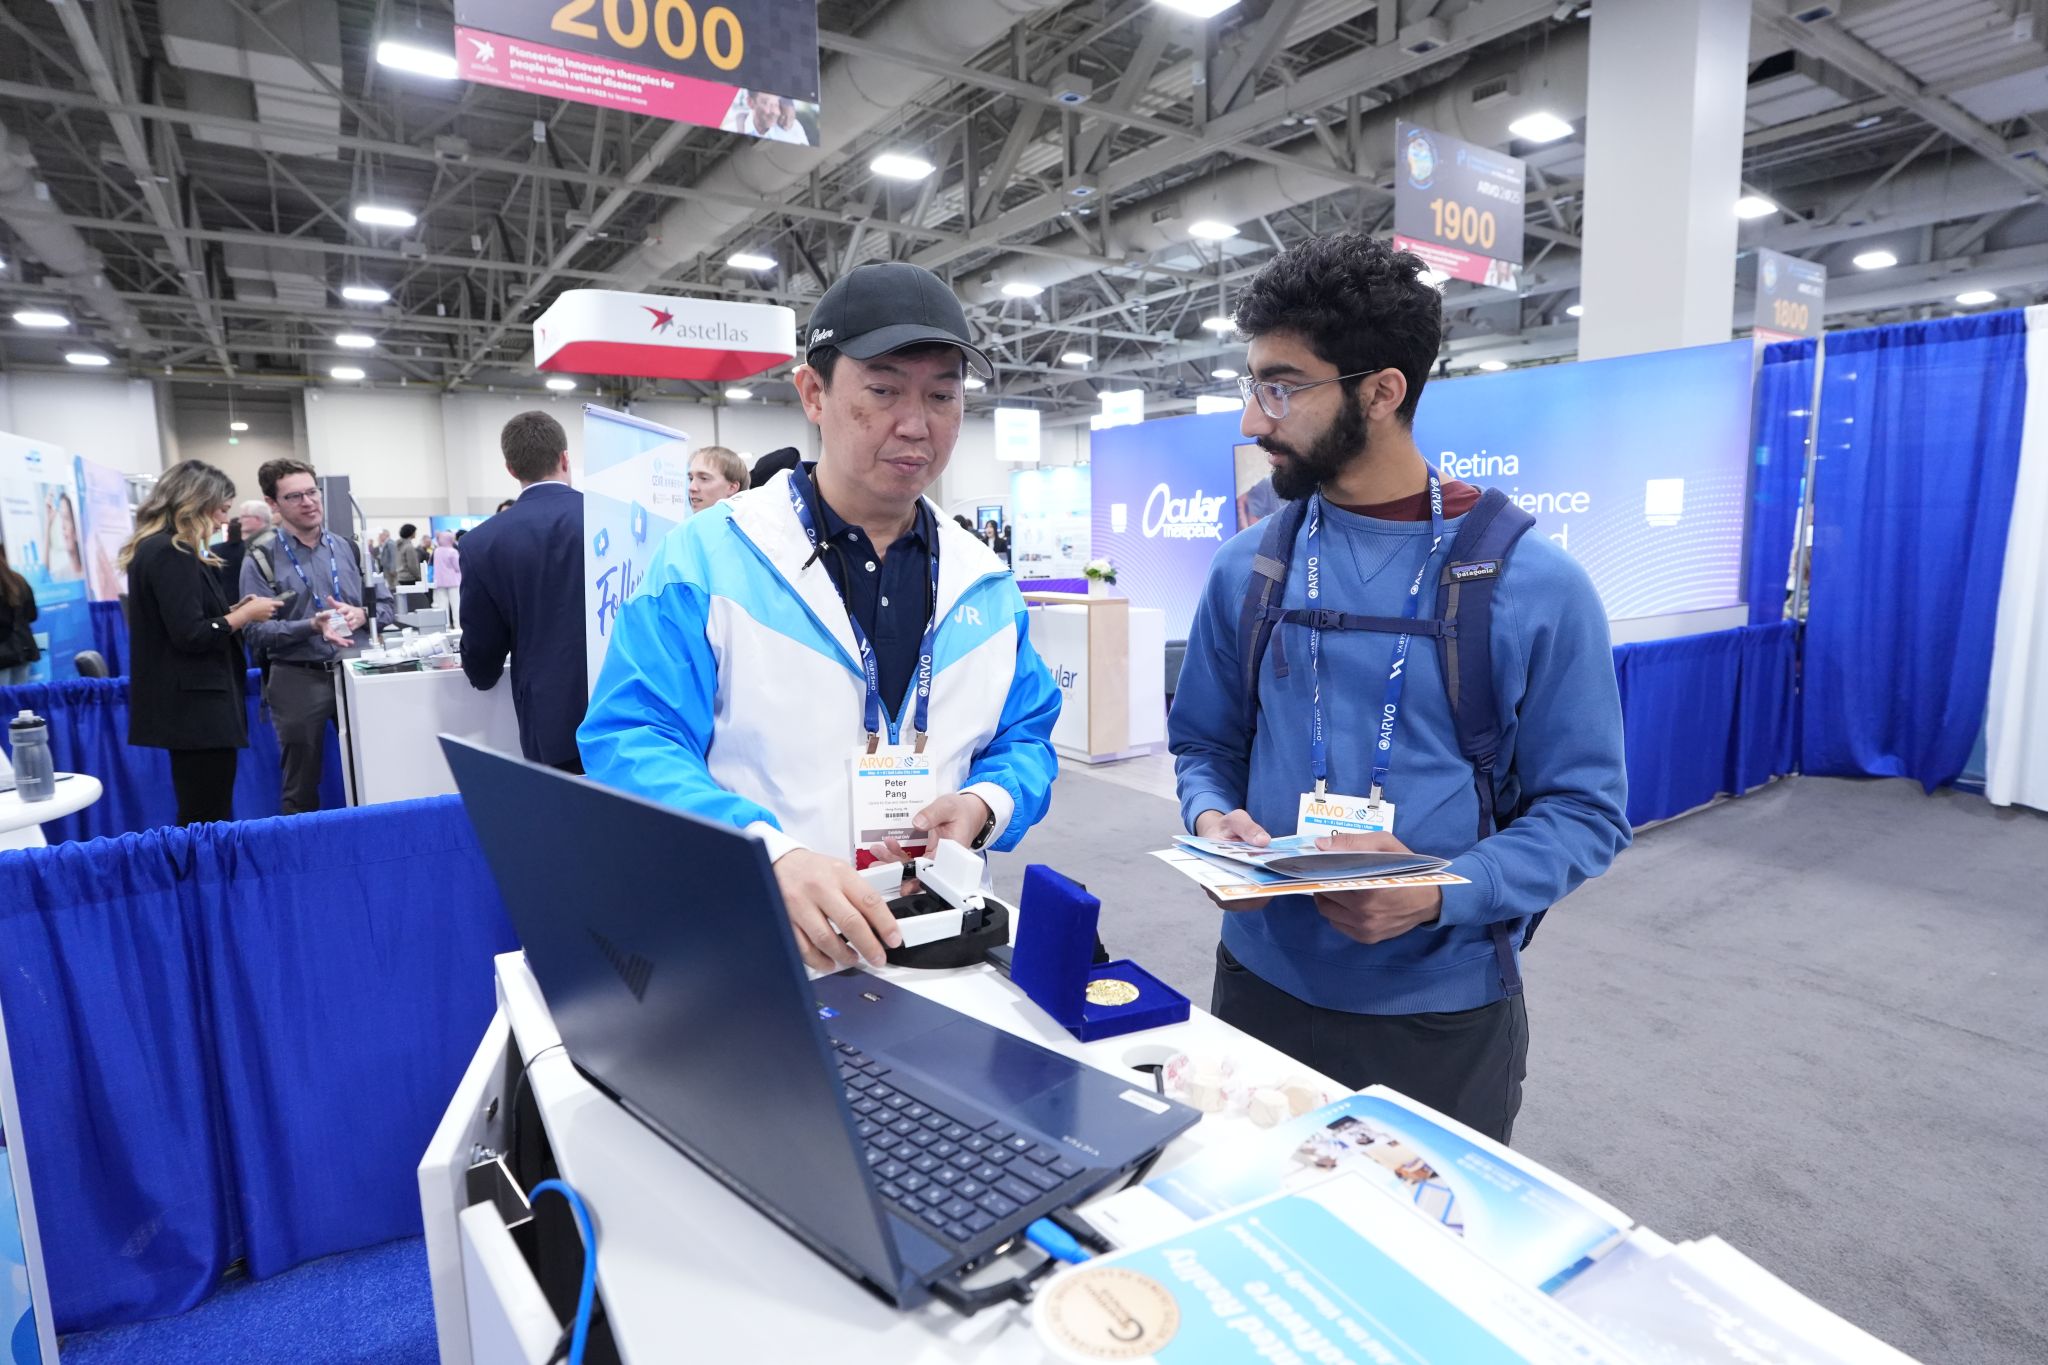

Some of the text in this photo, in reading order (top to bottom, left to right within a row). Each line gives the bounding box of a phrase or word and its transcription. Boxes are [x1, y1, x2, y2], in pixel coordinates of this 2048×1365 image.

[551, 0, 745, 71] 2000
[509, 45, 675, 90] Pioneering innovative therapies for
[509, 59, 643, 94] people with retinal diseases
[1430, 198, 1496, 250] 1900
[677, 322, 749, 343] astellas
[1440, 450, 1520, 478] Retina
[1142, 482, 1228, 539] Ocular
[1430, 486, 1442, 515] ARVO
[1308, 557, 1318, 589] ARVO
[1457, 567, 1493, 579] patagonia
[868, 659, 876, 691] VABYSMO
[919, 654, 932, 689] ARVO
[1382, 703, 1396, 741] ARVO
[884, 779, 907, 787] Peter
[885, 790, 907, 799] Pang
